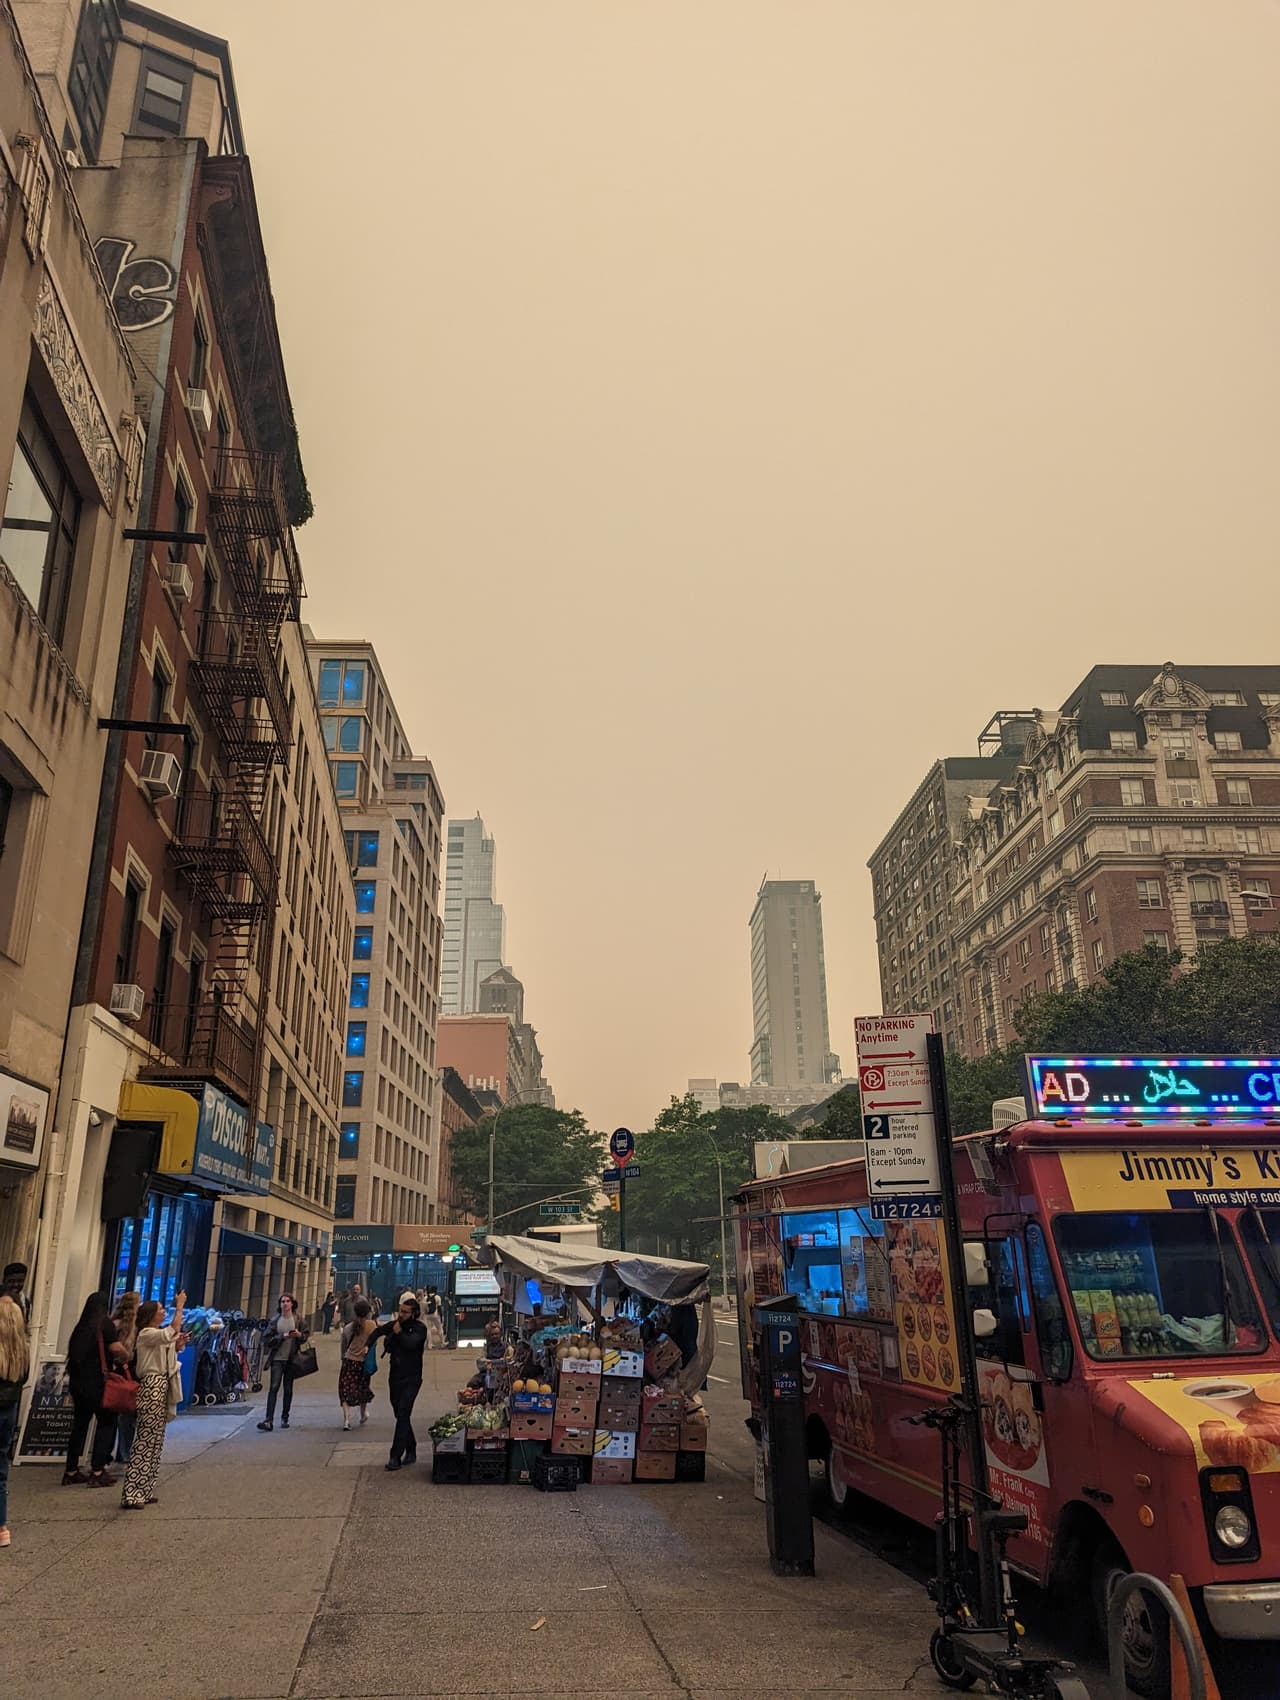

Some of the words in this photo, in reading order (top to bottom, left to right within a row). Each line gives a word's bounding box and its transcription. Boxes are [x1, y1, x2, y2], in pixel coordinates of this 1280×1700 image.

[859, 1022, 872, 1031] NO
[874, 1020, 915, 1031] PARKING
[861, 1033, 898, 1045] Anytime
[887, 1079, 909, 1088] Except
[910, 1078, 930, 1087] Sunda
[1042, 1073, 1090, 1101] AD
[1144, 1070, 1200, 1103] حلال
[870, 1116, 884, 1138] 2
[892, 1124, 919, 1132] metered
[892, 1131, 917, 1140] parking
[870, 1148, 887, 1157] 8am
[893, 1147, 913, 1157] 10pm
[871, 1157, 897, 1167] Except
[898, 1156, 926, 1167] Sunday
[1119, 1150, 1241, 1187] Jimmy's
[1193, 1191, 1228, 1205] home
[1231, 1190, 1257, 1206] style
[873, 1203, 932, 1218] 112724
[768, 1314, 792, 1323] 112724
[779, 1330, 793, 1352] P
[989, 1467, 1003, 1486] Mr.
[1002, 1472, 1024, 1495] Frank
